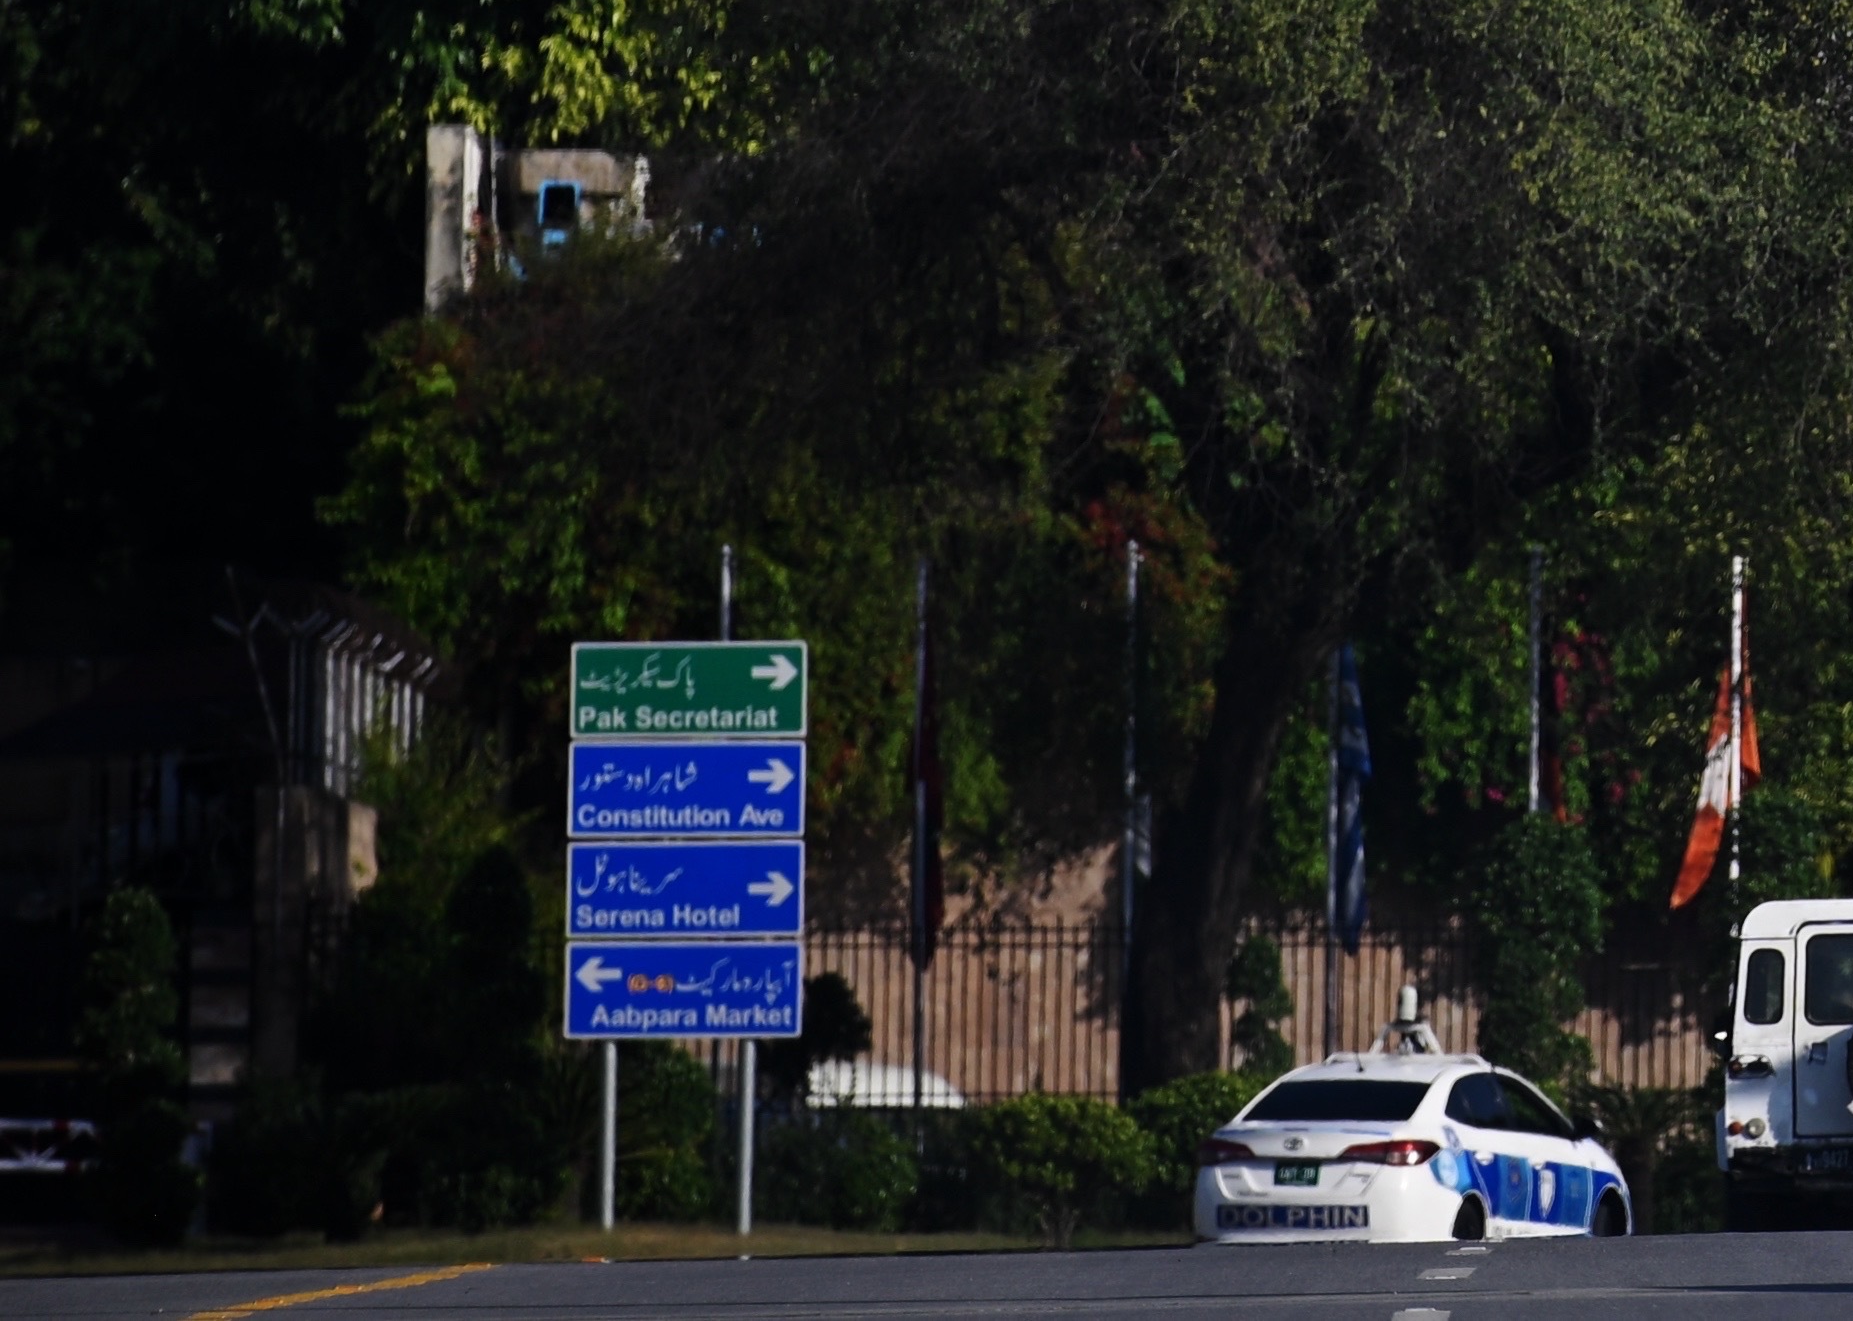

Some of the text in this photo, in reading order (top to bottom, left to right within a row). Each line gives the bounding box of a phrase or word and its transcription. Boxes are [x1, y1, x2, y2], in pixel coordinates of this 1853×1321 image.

[657, 654, 695, 700] پاک
[579, 705, 778, 729] Pak Secretariat
[577, 803, 784, 828] Constitution Ave
[575, 851, 628, 898] ہوٹل
[576, 903, 740, 929] Serena Hotel
[591, 1003, 793, 1033] Aabpara Market
[1219, 1205, 1365, 1228] DOLPHIN
